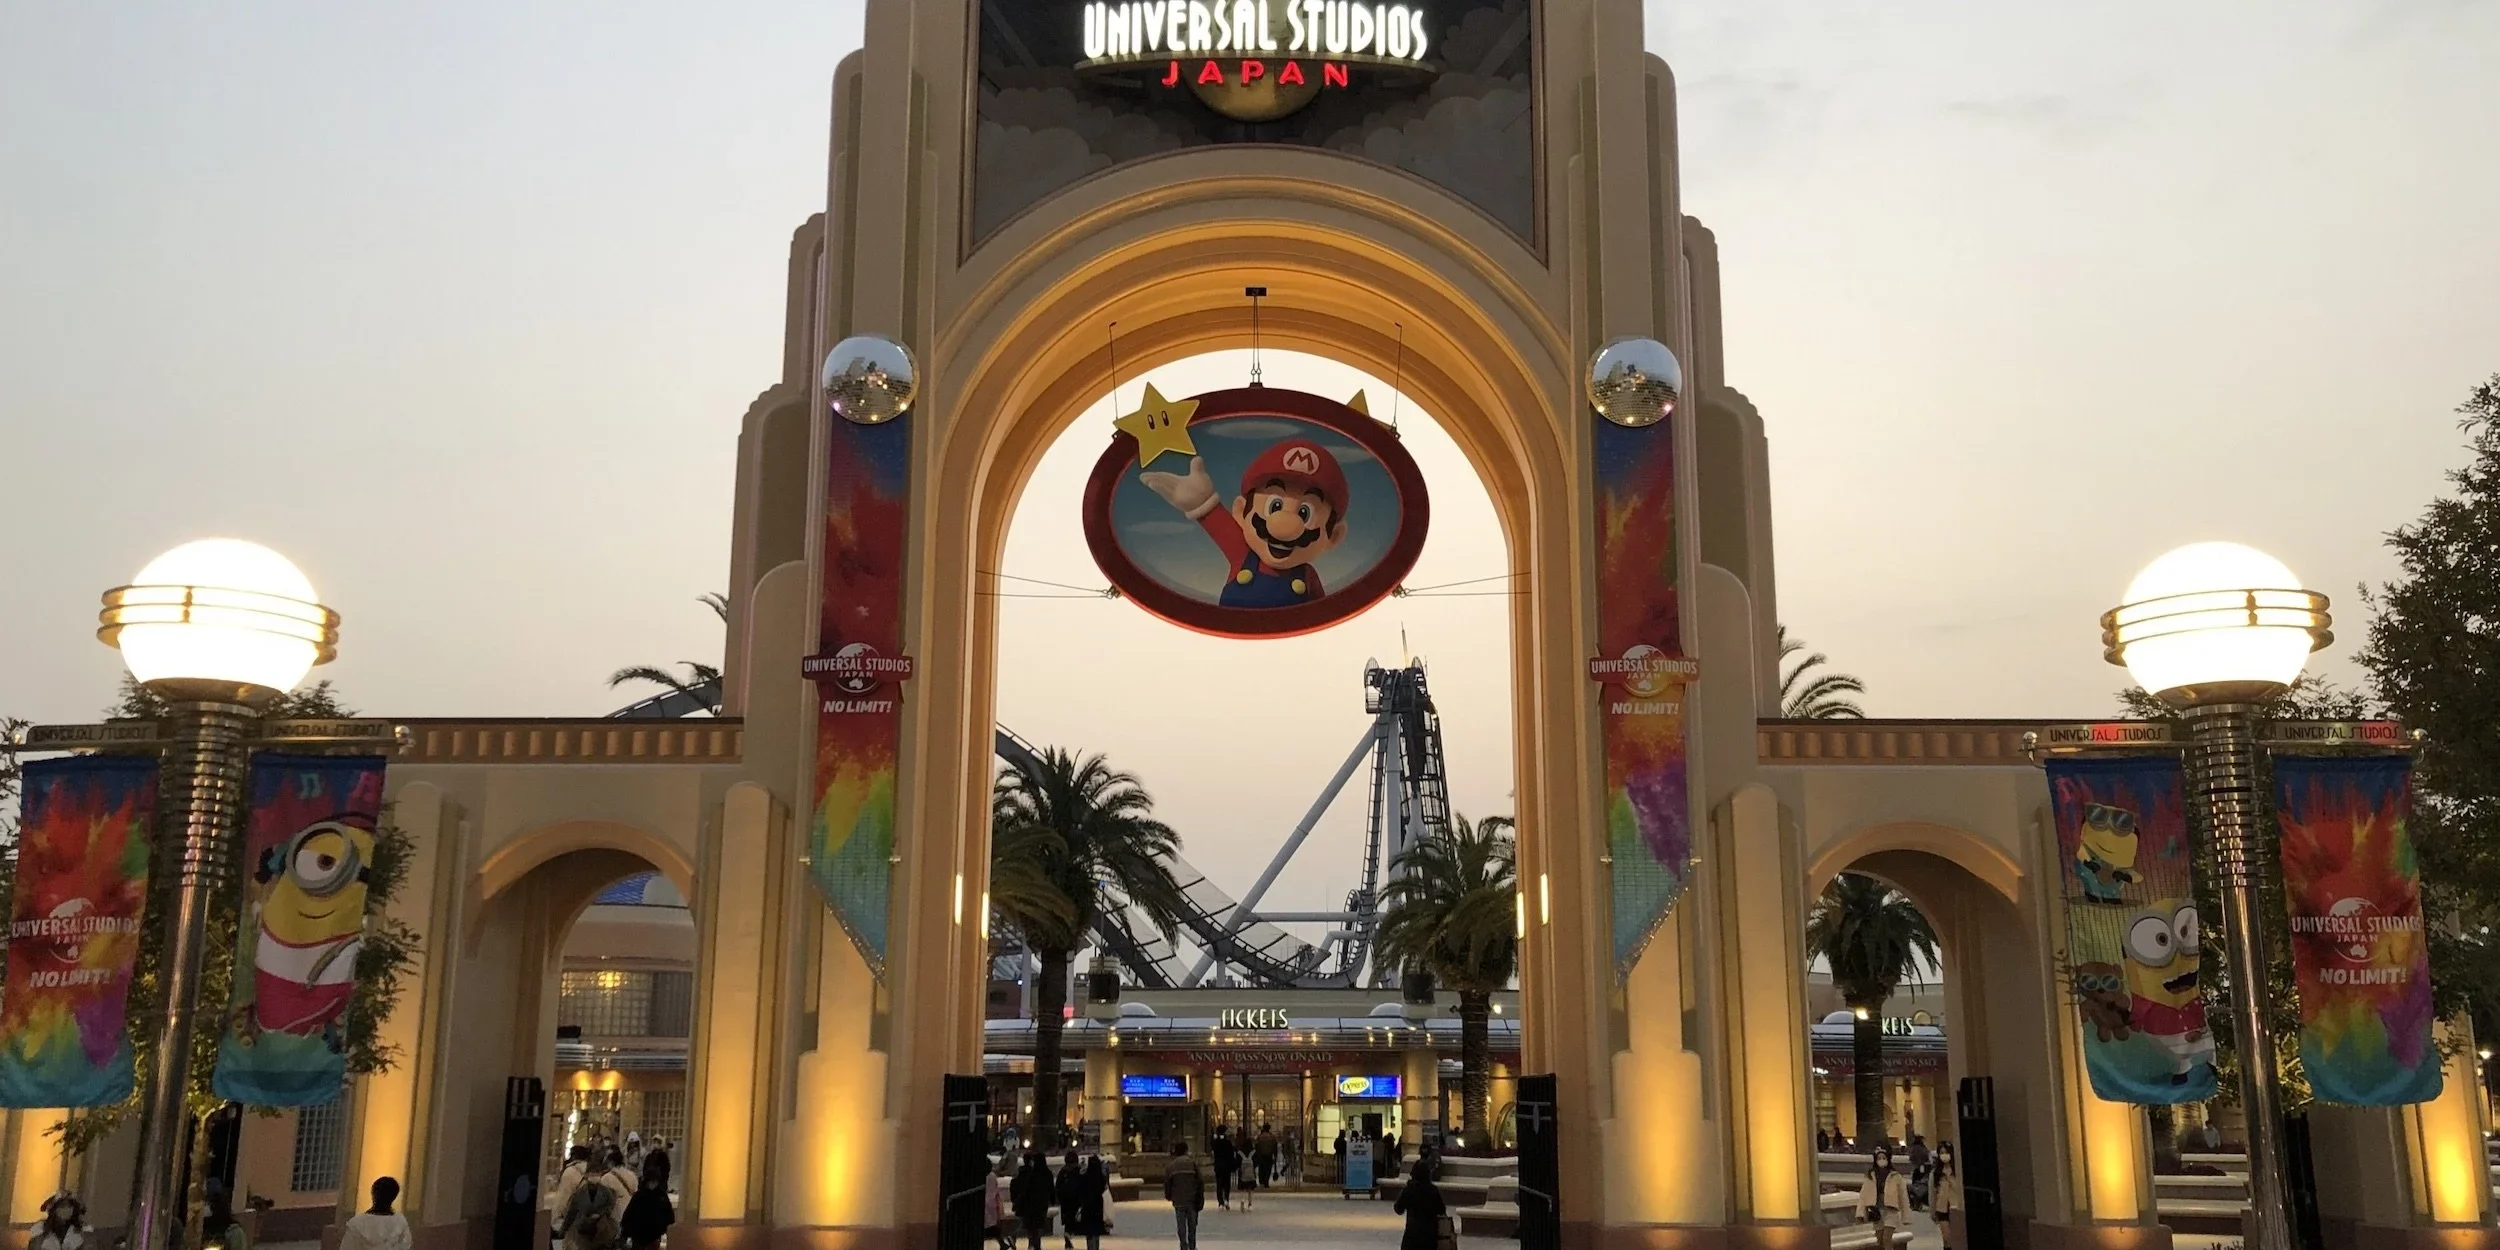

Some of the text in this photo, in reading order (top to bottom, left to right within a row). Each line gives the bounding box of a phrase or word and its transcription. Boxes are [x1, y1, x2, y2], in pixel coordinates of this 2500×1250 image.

[1084, 0, 1428, 60] UNIVERSAL STUDIOS
[1161, 59, 1348, 87] JAPAN
[804, 658, 911, 673] UNIVERSAL STUDIOS
[1591, 660, 1698, 674] UNIVERSAL STUDIOS
[823, 701, 892, 713] NO LIMIT!
[1611, 702, 1680, 715] NO LIMIT!
[2050, 727, 2164, 742] UNIVERSAL STUDIOS
[2285, 726, 2399, 739] UNIVERSAL STUDIOS
[12, 915, 141, 938] UNIVERSAL STUDIOS
[2292, 915, 2422, 933] UNIVERSAL STUDIOS
[2337, 934, 2378, 943] JAPAN
[30, 971, 59, 988] NO
[2319, 967, 2407, 985] NO LIMIT!
[1221, 1008, 1288, 1029] TICKETS
[1882, 1017, 1915, 1036] KETS
[1188, 1051, 1230, 1062] ANNUAL
[1233, 1051, 1258, 1062] PASS
